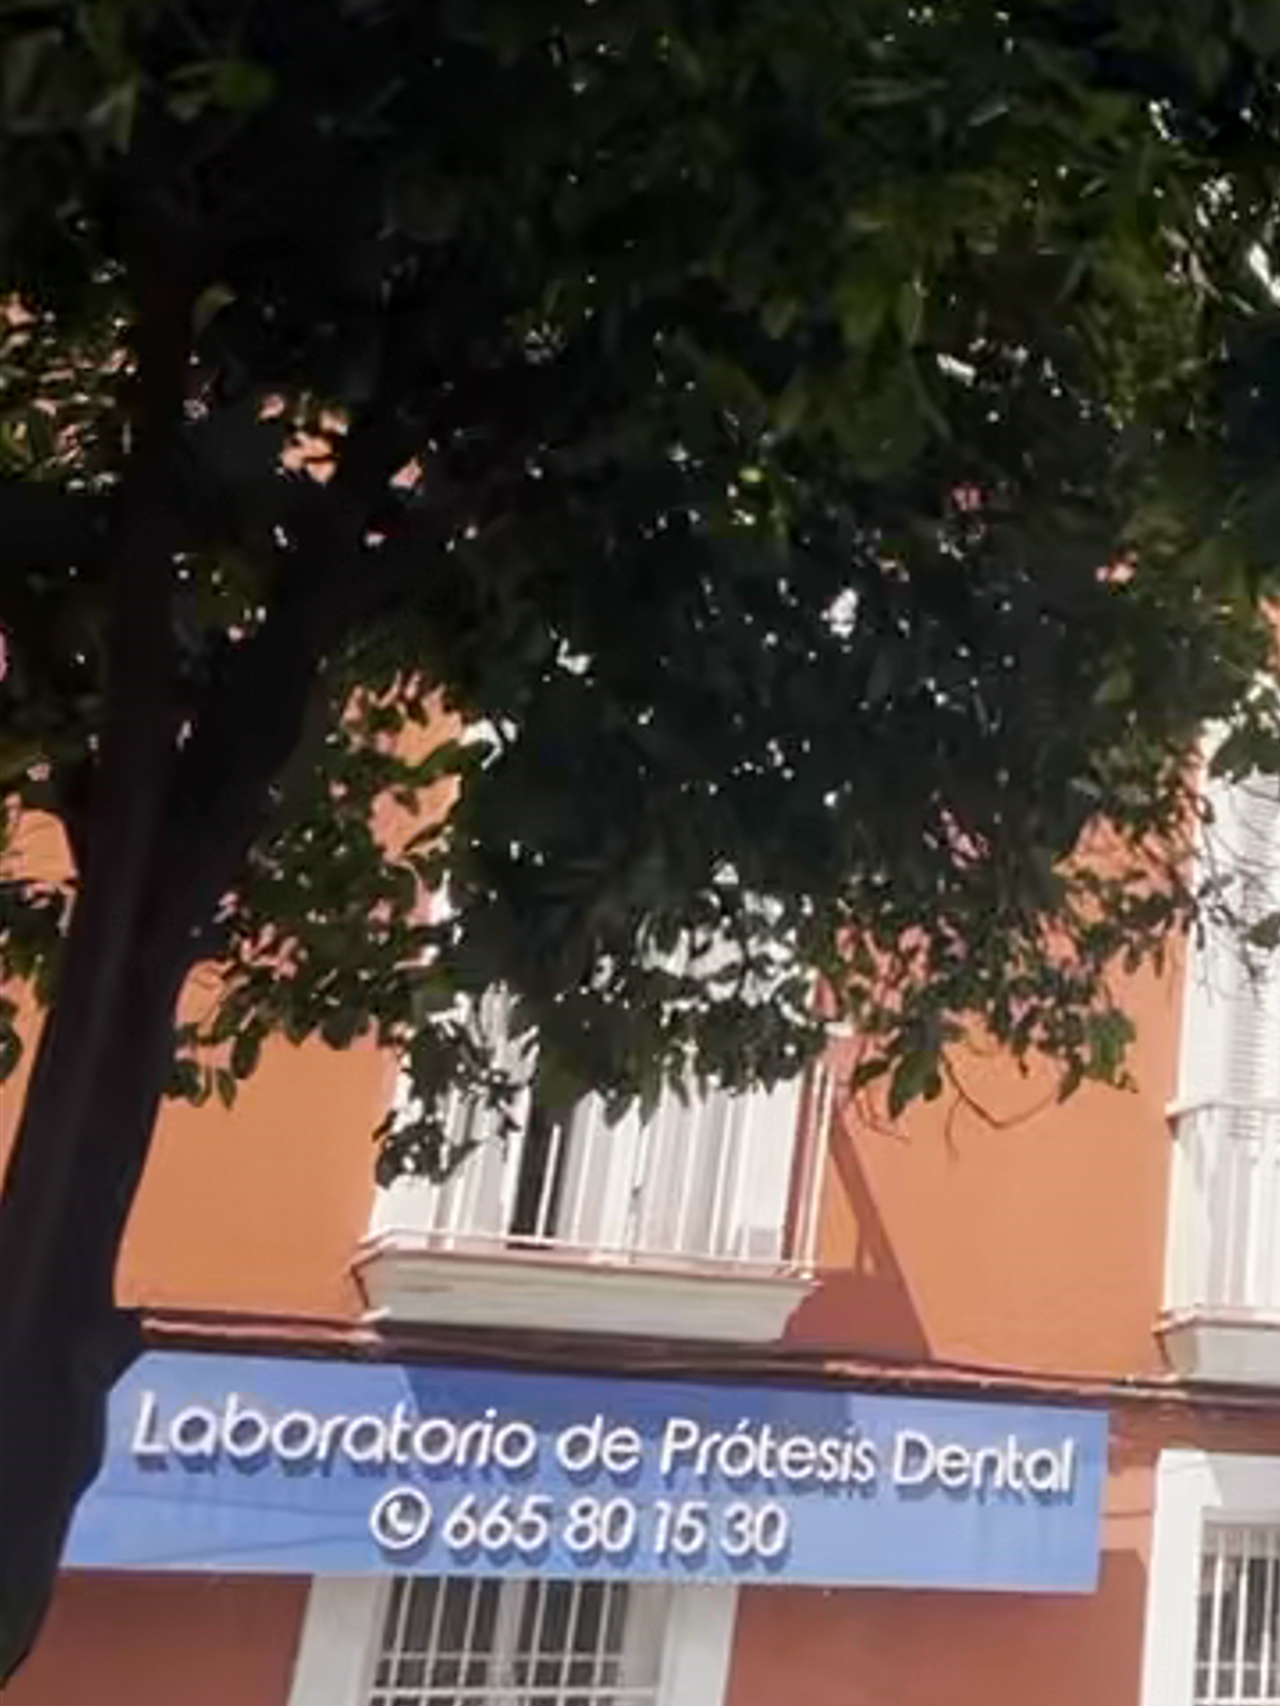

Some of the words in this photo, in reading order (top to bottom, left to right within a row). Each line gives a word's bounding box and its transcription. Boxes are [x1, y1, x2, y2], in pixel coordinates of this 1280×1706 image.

[131, 1390, 537, 1469] Laboratorio
[556, 1412, 641, 1472] de
[659, 1417, 876, 1483] Prótesis
[892, 1428, 1074, 1493] Dental
[442, 1493, 553, 1551] 665
[563, 1496, 637, 1554] 80
[653, 1499, 707, 1555] 15
[718, 1501, 789, 1557] 30
